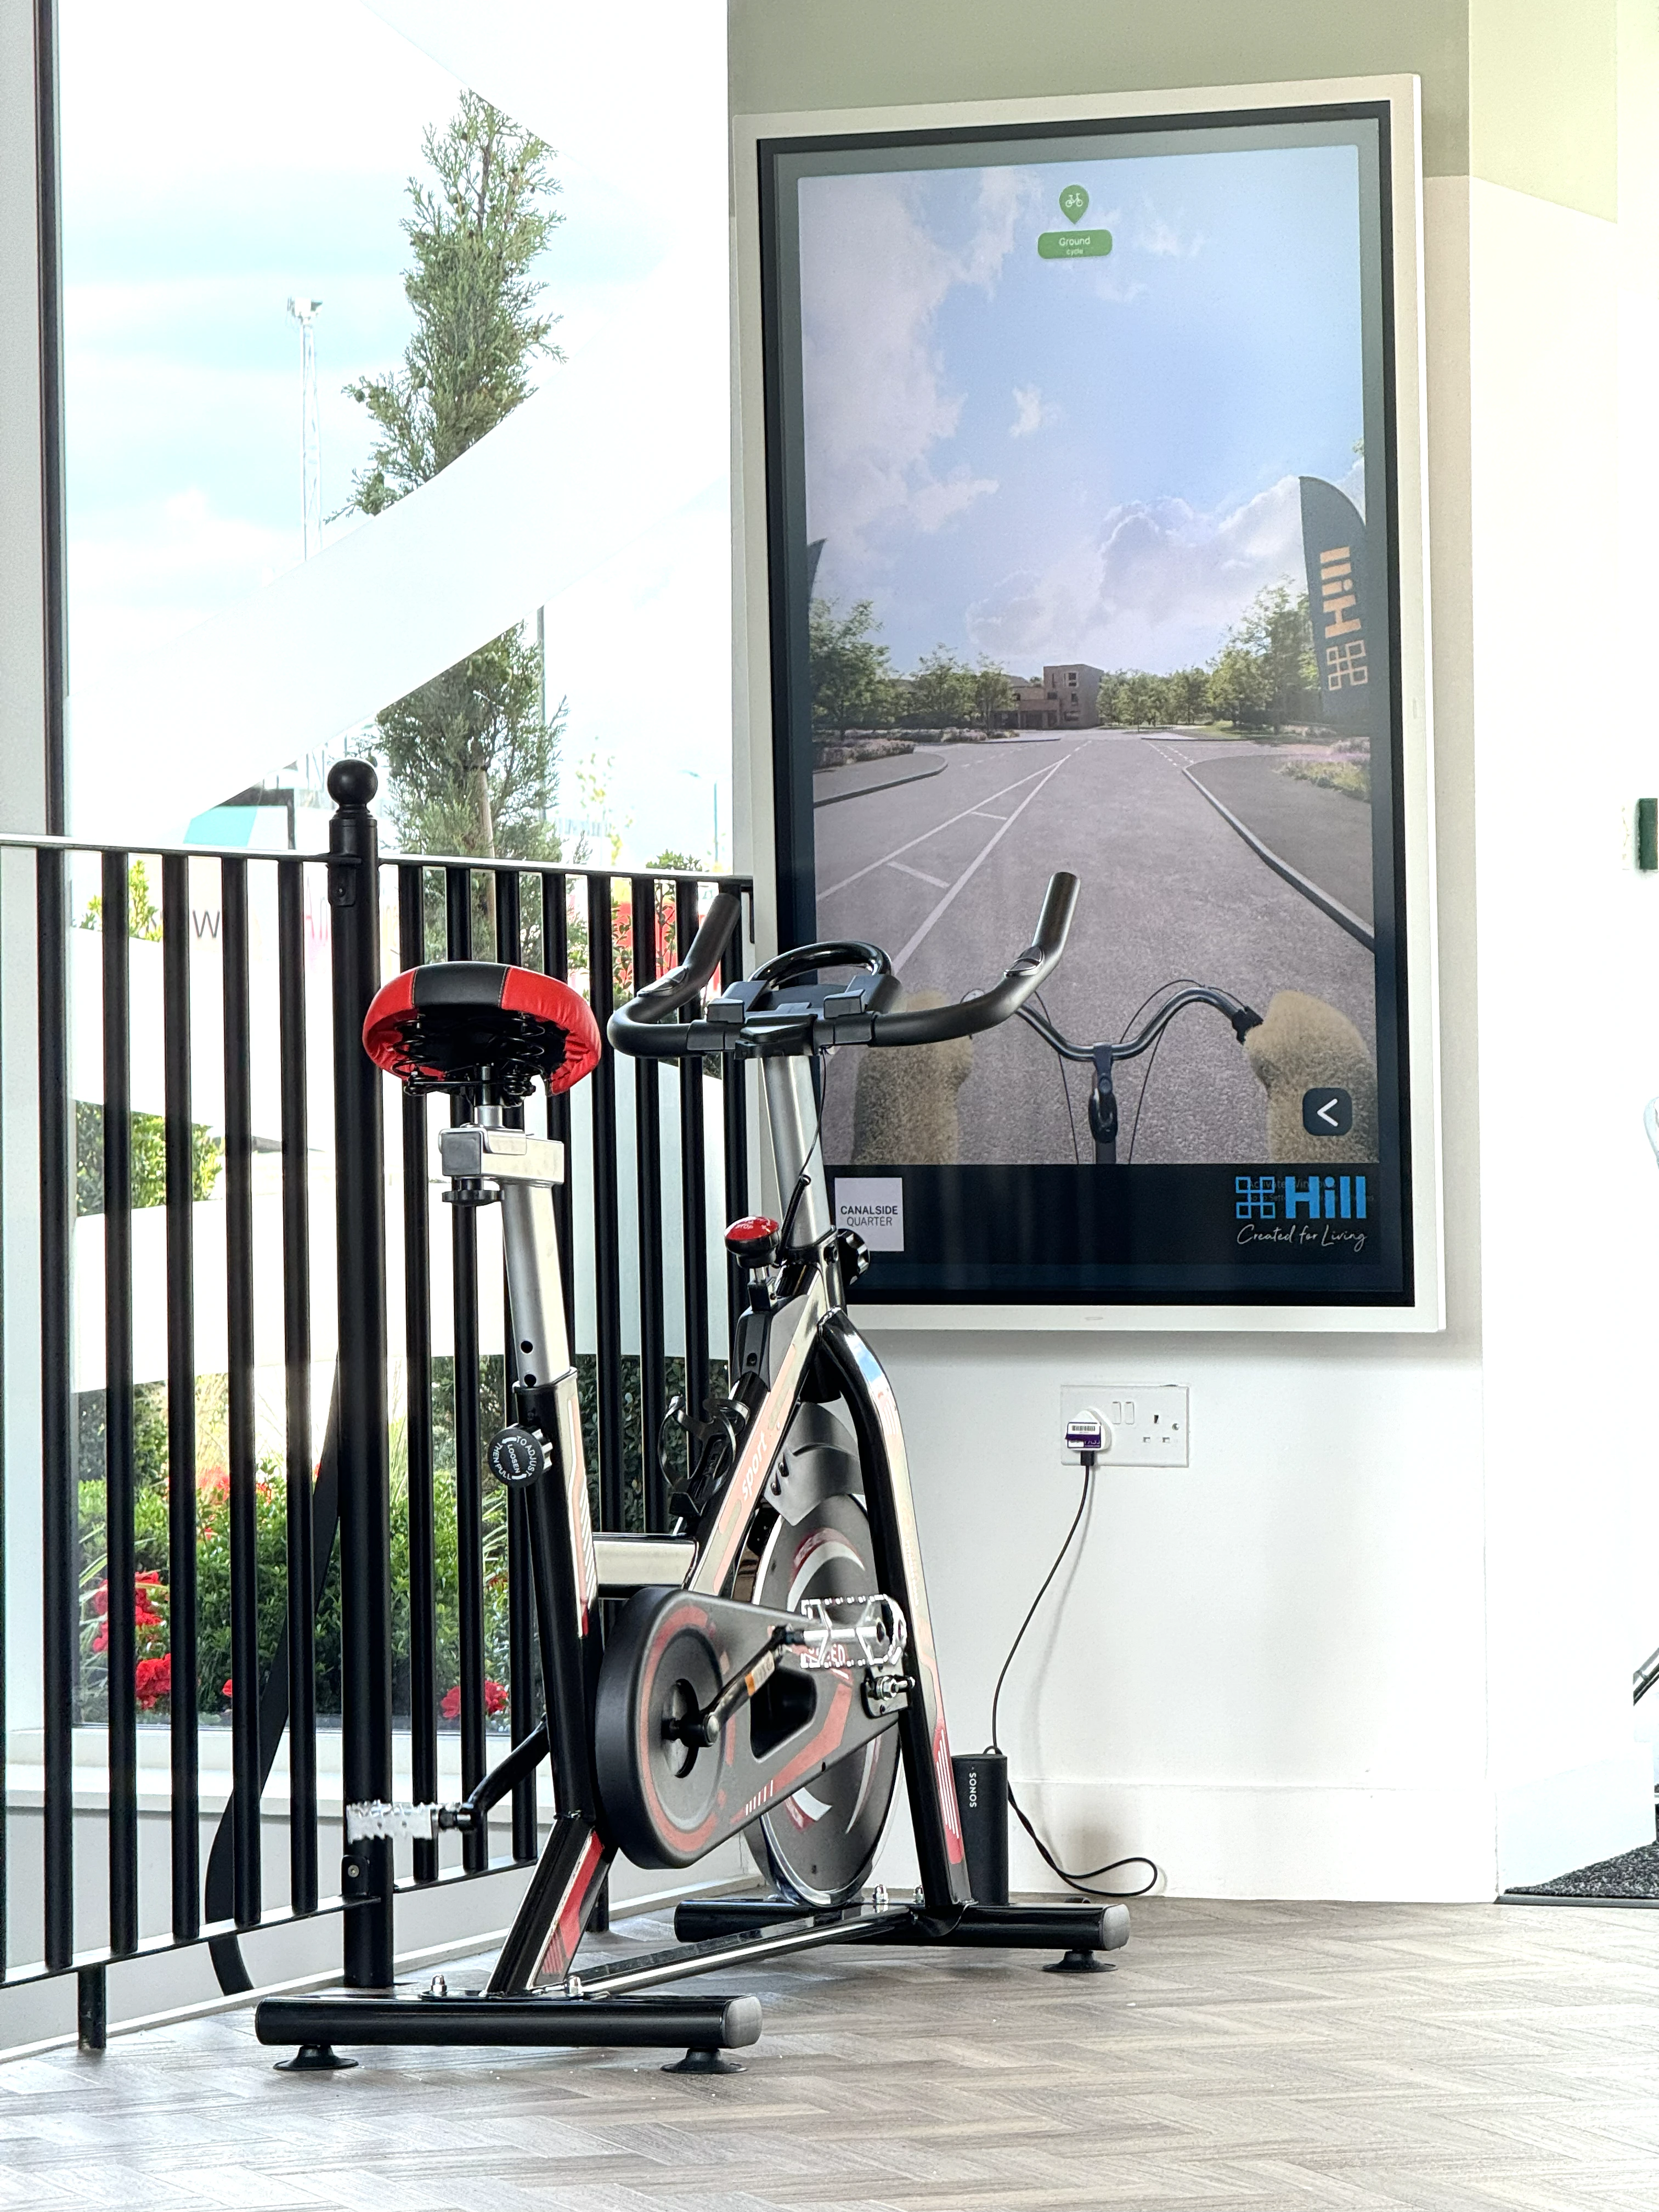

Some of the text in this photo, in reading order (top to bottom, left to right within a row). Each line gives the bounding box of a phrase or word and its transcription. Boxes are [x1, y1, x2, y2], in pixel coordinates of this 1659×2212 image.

[1058, 237, 1091, 246] Ground
[1319, 546, 1362, 639] Hill
[840, 1205, 899, 1215] CANALSIDE
[1285, 1176, 1367, 1219] Hill
[847, 1216, 893, 1227] QUARTER
[1237, 1224, 1368, 1252] Created for Living
[493, 1442, 512, 1480] THEN PULL
[507, 1443, 521, 1474] LOOSEN
[516, 1435, 537, 1477] TO ADJUST
[742, 1430, 768, 1502] sport
[969, 1772, 977, 1808] SONOS
